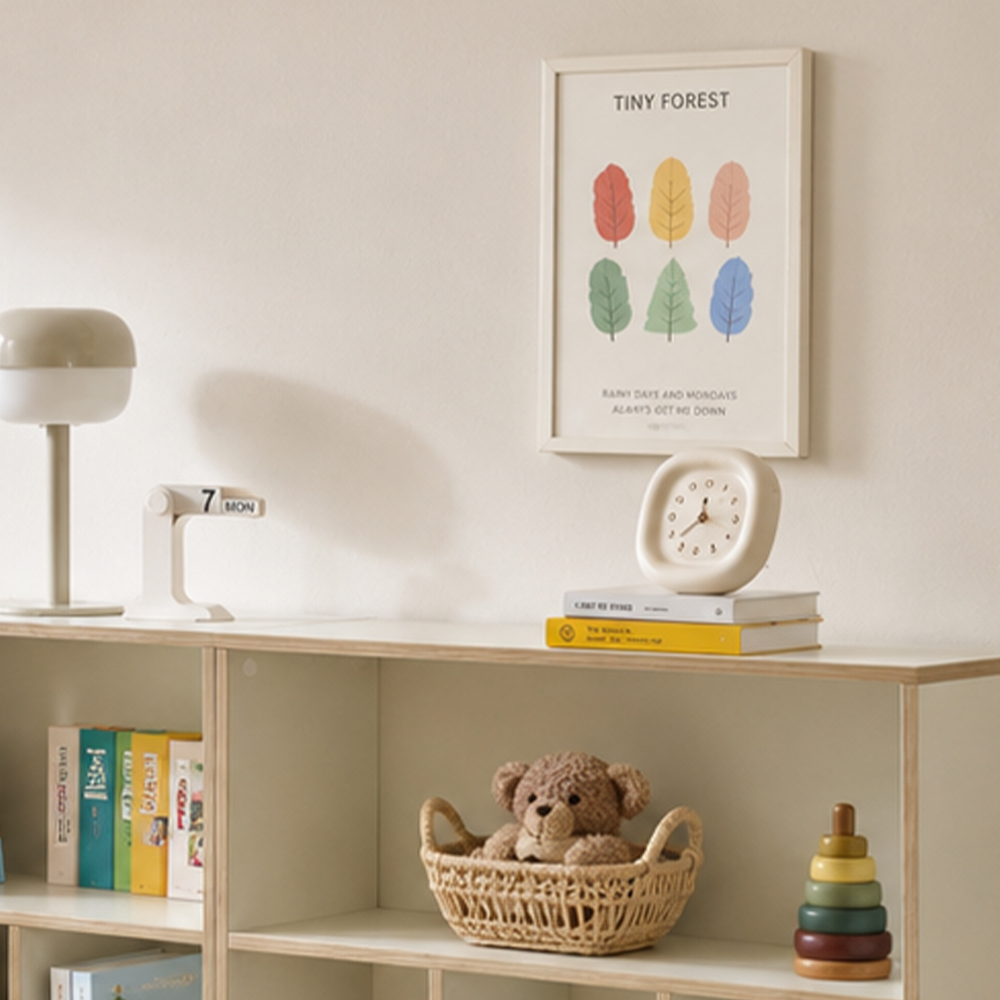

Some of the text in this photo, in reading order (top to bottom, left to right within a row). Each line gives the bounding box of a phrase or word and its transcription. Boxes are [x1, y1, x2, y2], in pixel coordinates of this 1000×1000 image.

[613, 91, 730, 111] TINY FOREST
[202, 489, 216, 513] 7
[226, 501, 255, 513] MON
